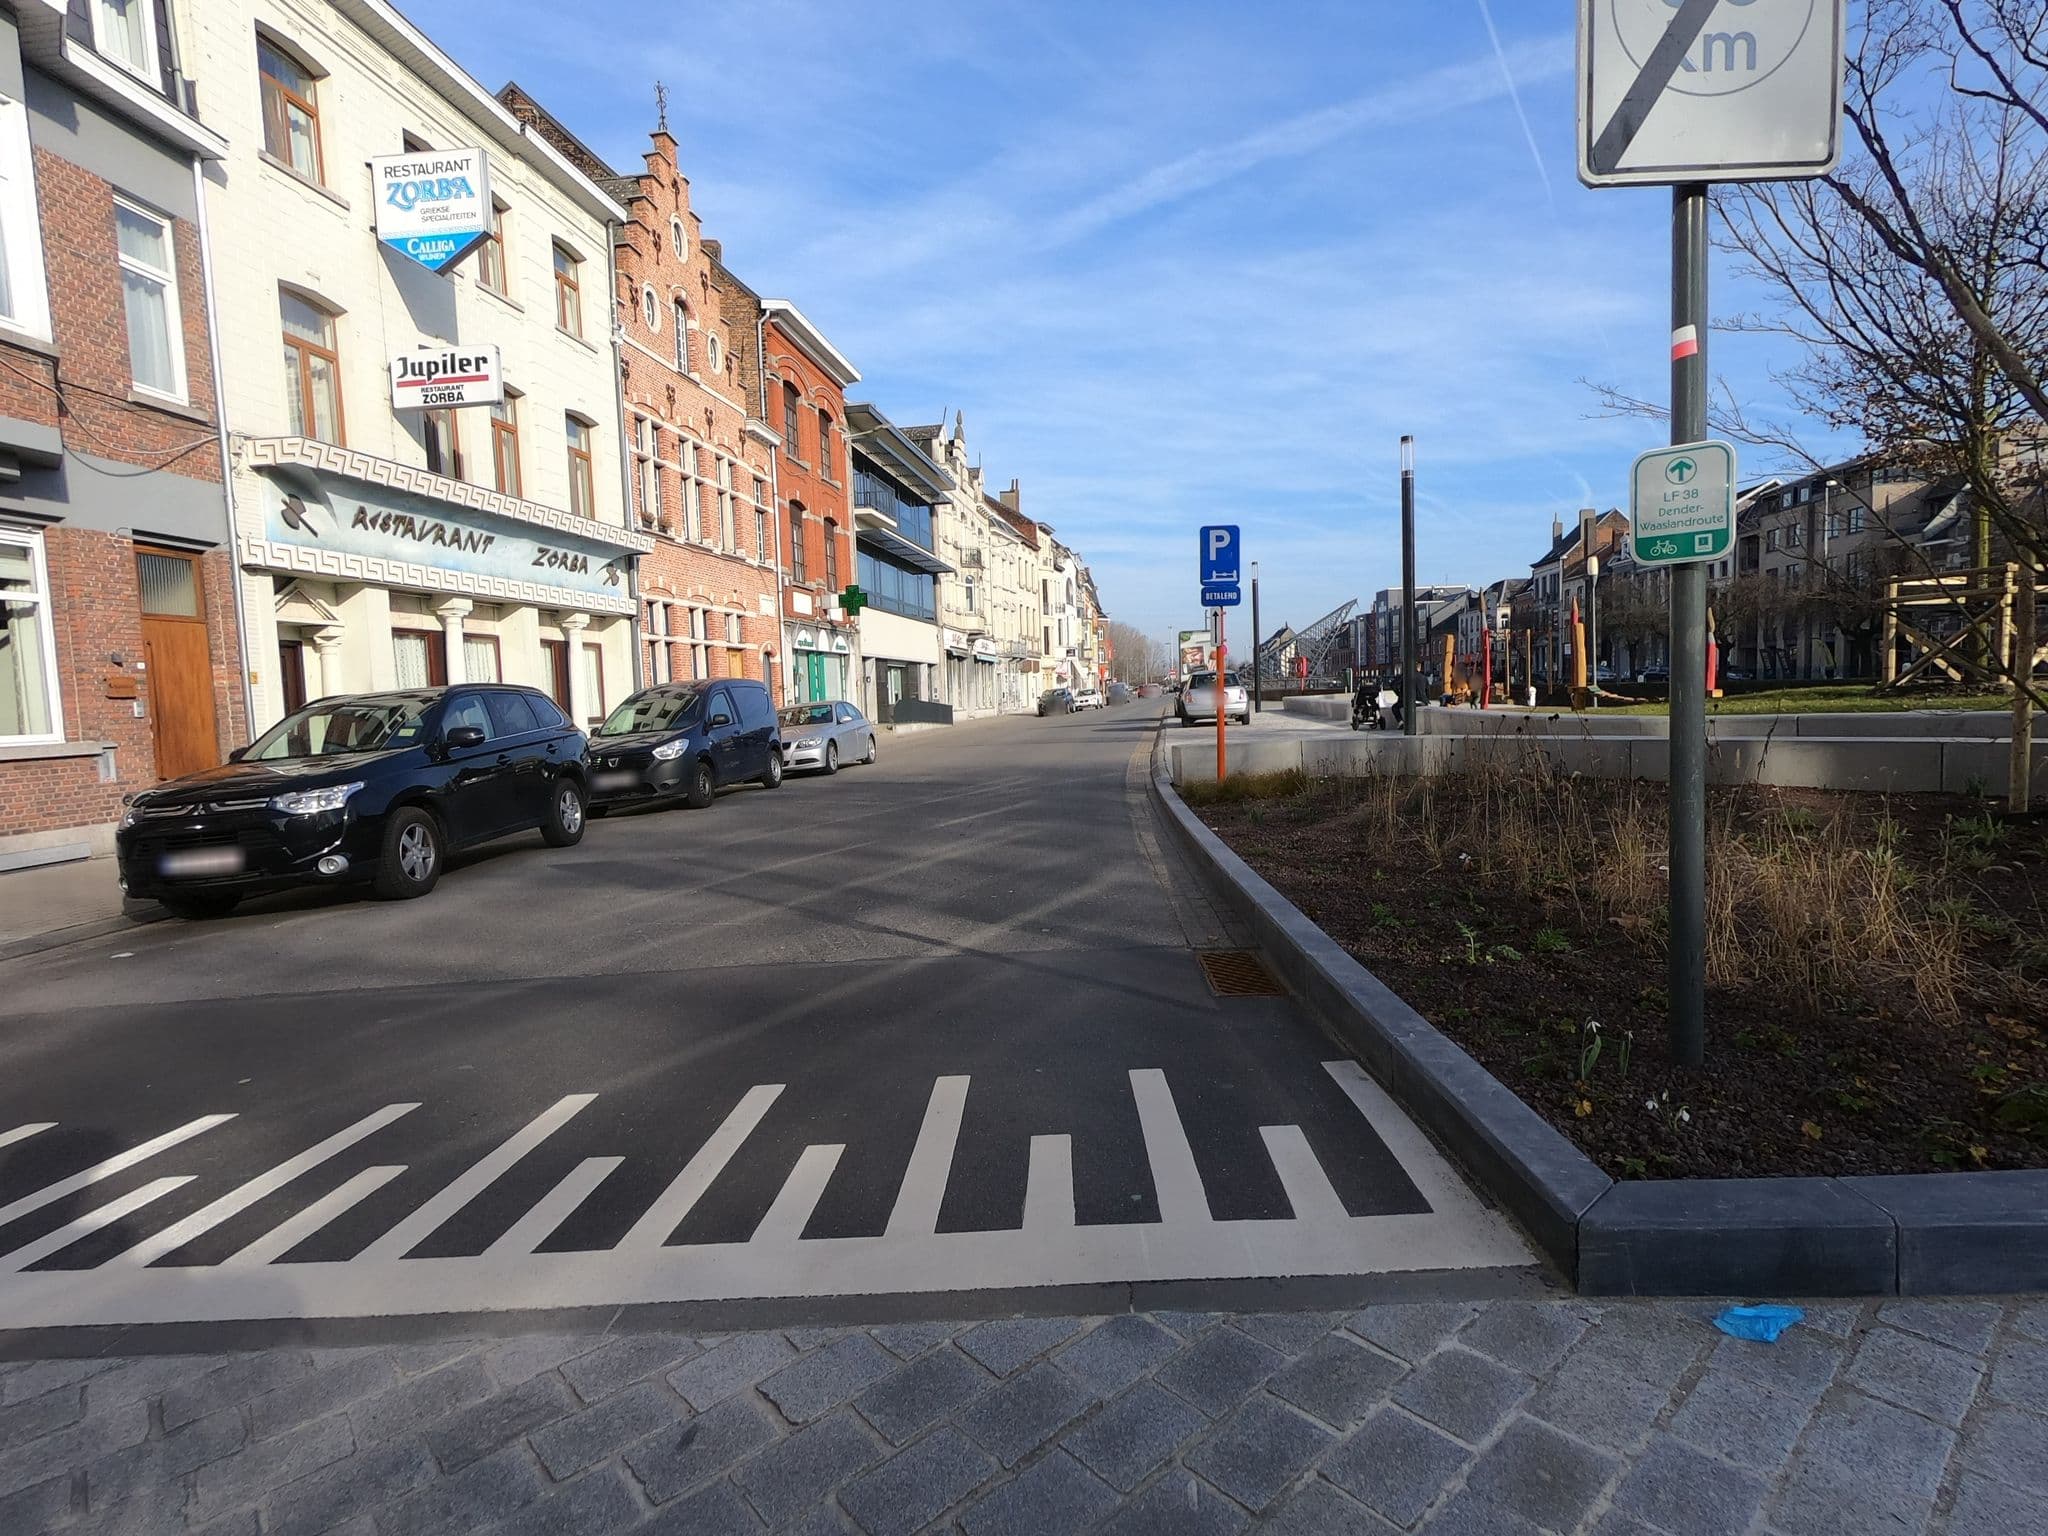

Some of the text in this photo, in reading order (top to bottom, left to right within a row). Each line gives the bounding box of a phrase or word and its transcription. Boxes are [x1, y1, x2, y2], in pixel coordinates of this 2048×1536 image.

[384, 158, 472, 178] RESTAURANT
[386, 176, 475, 211] ZORBA
[420, 206, 450, 215] GRIEKSE
[420, 211, 477, 223] SPECIALITEITEN
[397, 353, 488, 382] Jupiler
[421, 384, 464, 393] RESTAURANT
[422, 392, 464, 404] ZORBA
[1663, 488, 1699, 502] LF 38
[1658, 504, 1704, 517] Dender-
[1640, 514, 1724, 531] Waaslandroute
[1209, 529, 1231, 561] P
[531, 547, 588, 575] ZORBA
[1205, 592, 1238, 600] BETALEND
